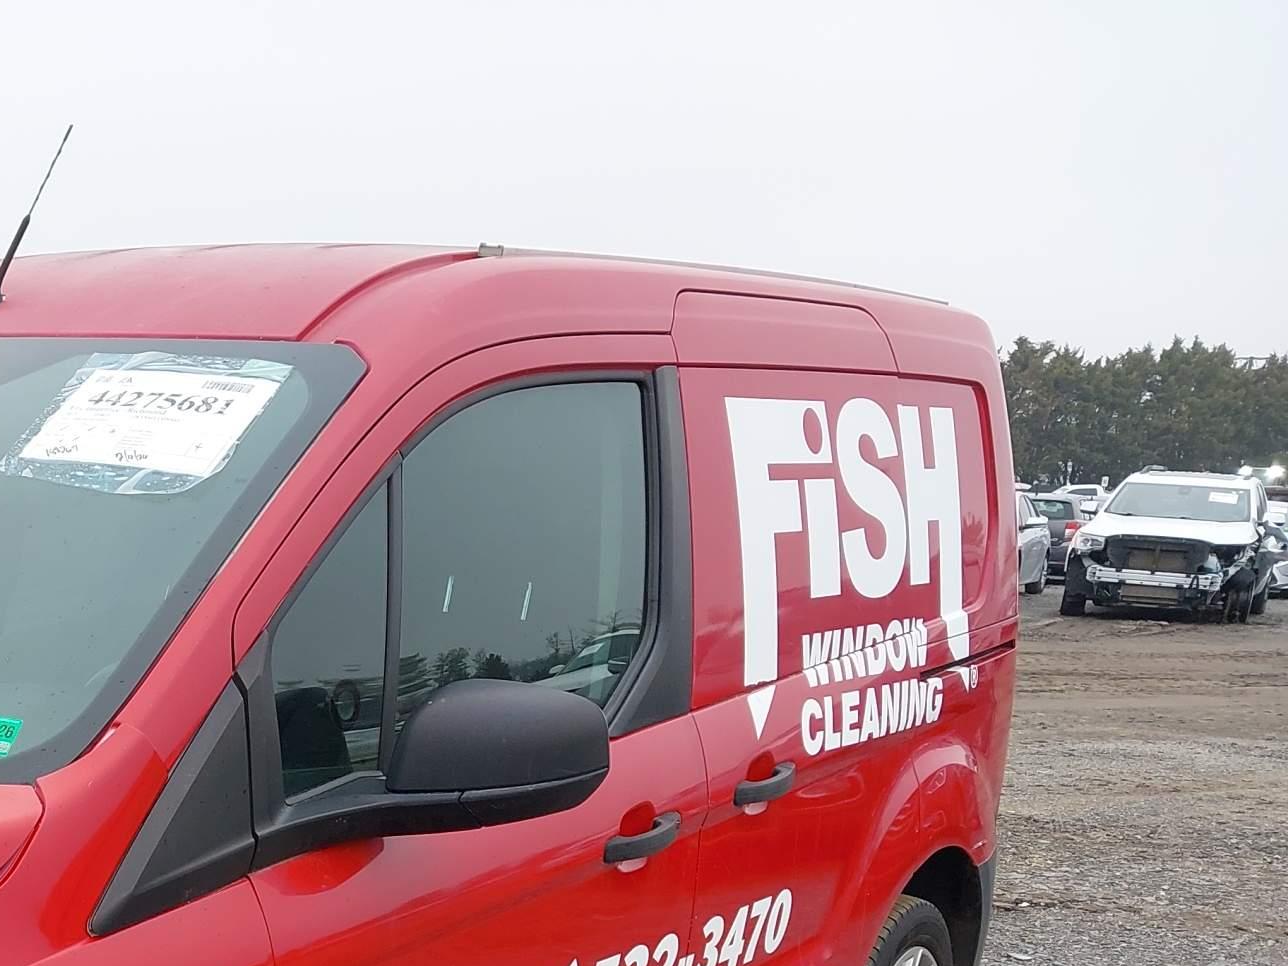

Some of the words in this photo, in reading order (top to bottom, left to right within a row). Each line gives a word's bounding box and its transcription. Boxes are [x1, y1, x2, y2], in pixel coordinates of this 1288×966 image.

[88, 390, 234, 416] 44275681
[802, 617, 928, 687] WINDOW
[801, 677, 943, 756] CLEANING
